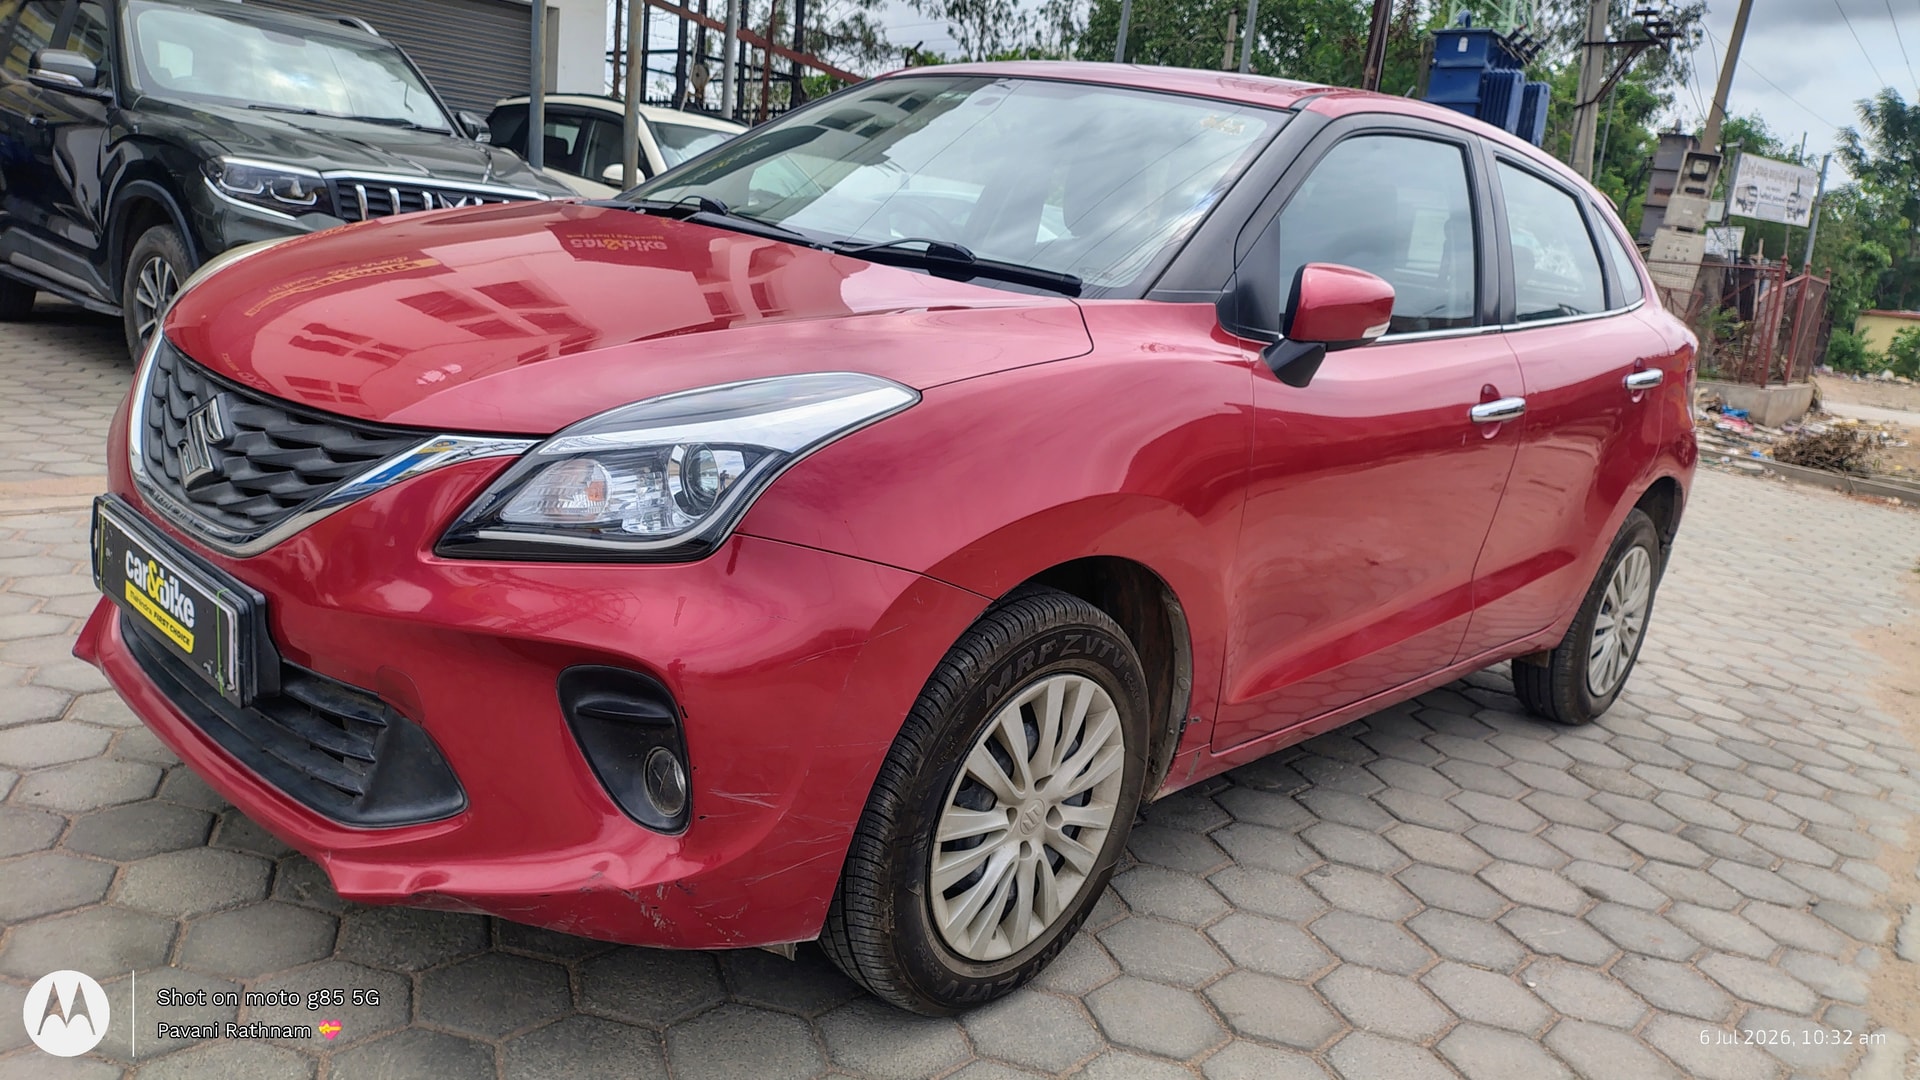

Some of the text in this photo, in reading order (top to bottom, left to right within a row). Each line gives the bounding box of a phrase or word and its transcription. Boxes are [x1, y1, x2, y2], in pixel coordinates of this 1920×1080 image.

[125, 550, 195, 628] car&bike
[985, 634, 1127, 708] MRF ZVTV
